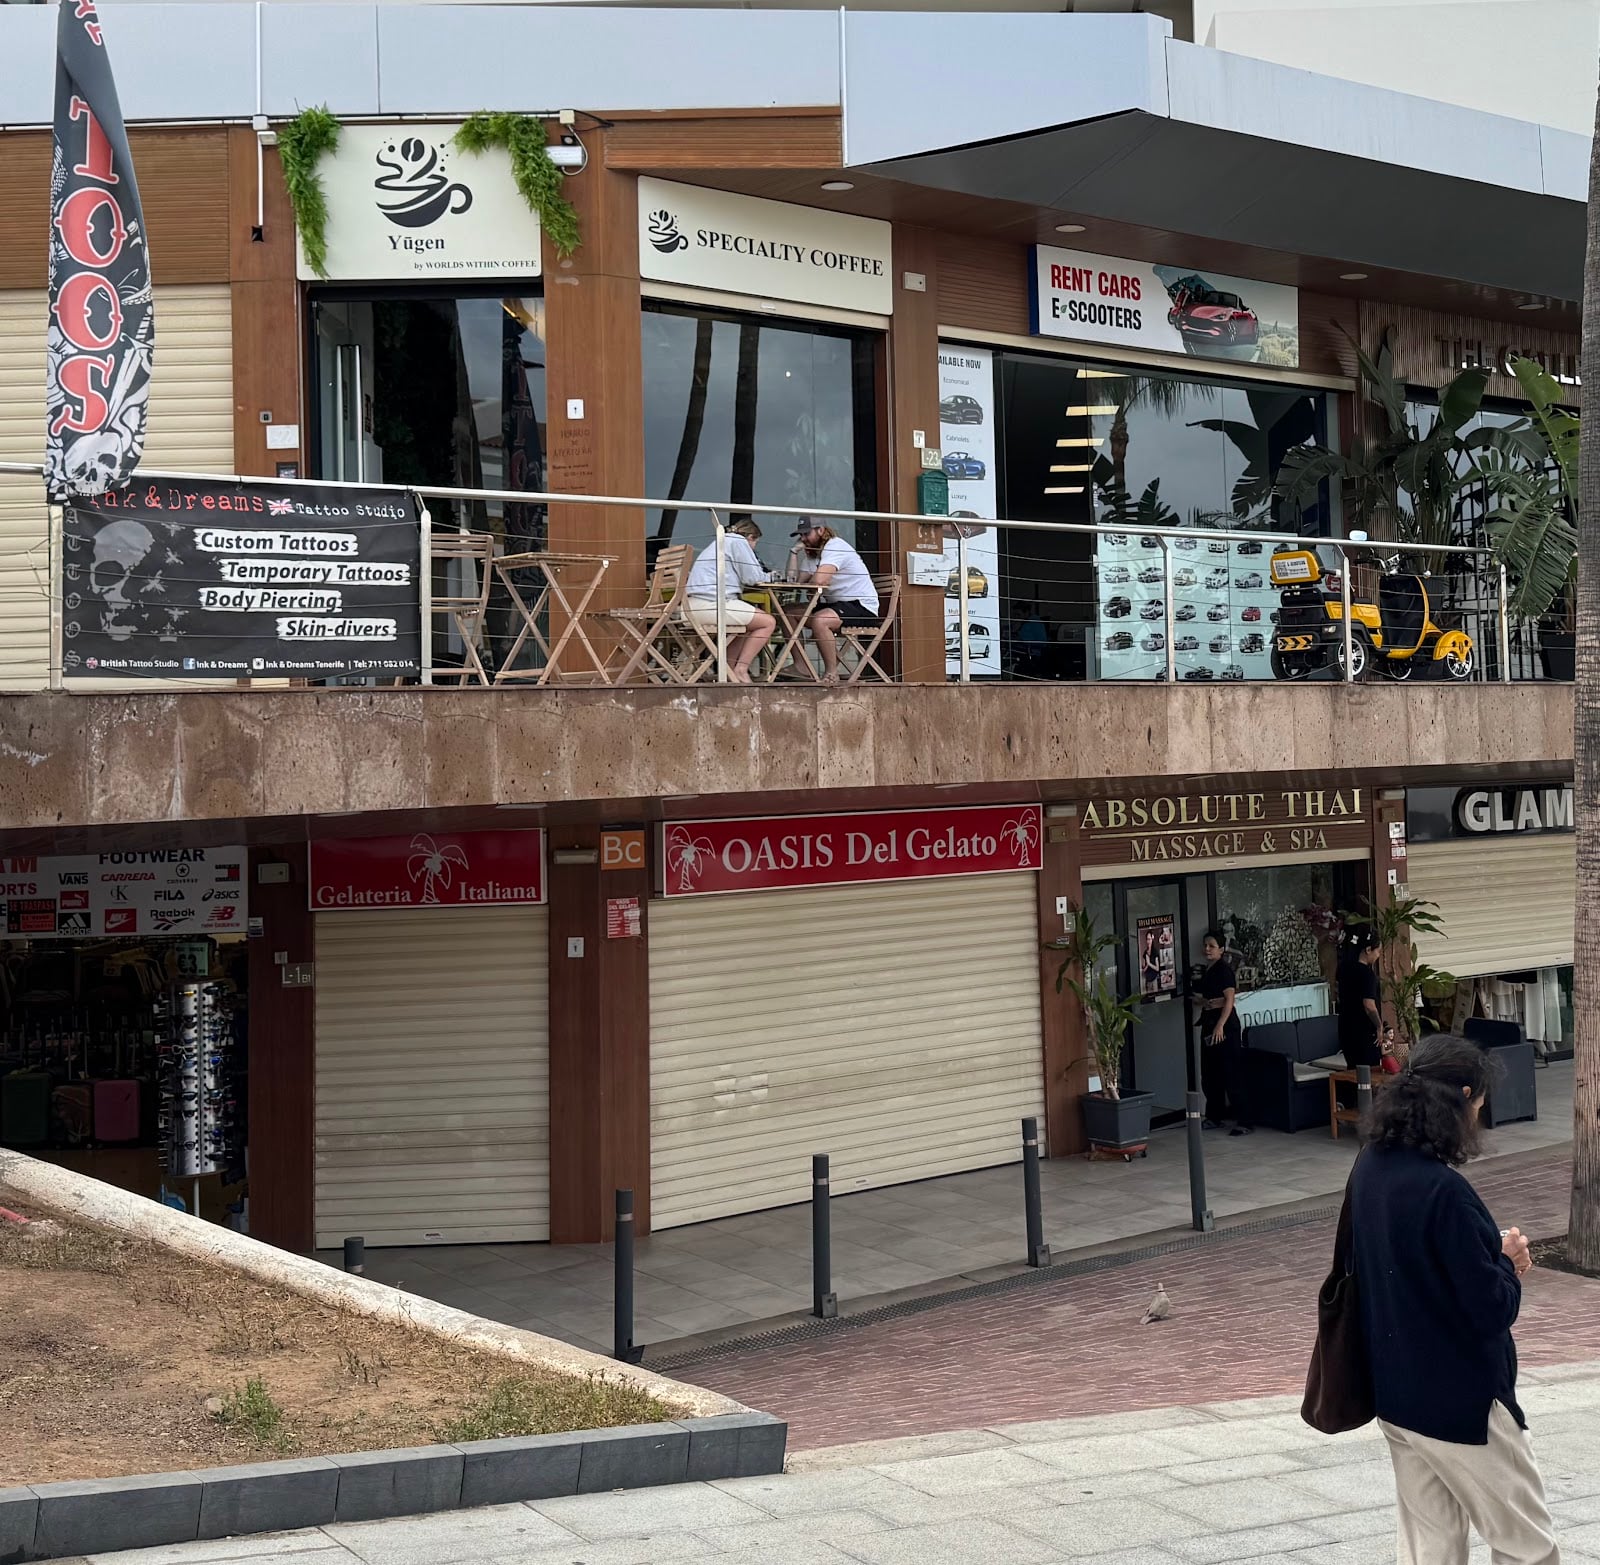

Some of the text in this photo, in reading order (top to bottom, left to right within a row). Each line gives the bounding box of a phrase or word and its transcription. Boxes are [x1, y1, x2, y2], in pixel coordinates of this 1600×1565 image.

[388, 235, 445, 254] Yūgen
[696, 229, 884, 277] SPECIALTY COFFEE
[414, 260, 537, 271] by WORLDS WITHIN COFFEE
[1050, 264, 1141, 301] RENT CARS
[966, 359, 981, 369] NOW
[145, 485, 163, 509] &
[168, 488, 263, 512] Dreams
[295, 502, 349, 517] Tattoo
[356, 504, 405, 519] Studio
[201, 532, 349, 552] Custom Tattoos
[227, 562, 403, 582] Temporary Tattoos
[205, 590, 337, 612] Body Piercing
[286, 620, 389, 636] Skin-divers
[101, 659, 179, 668] British Tattoo Studio
[197, 661, 209, 669] Ink
[219, 661, 247, 669] Dreams
[266, 660, 278, 668] Ink
[279, 660, 285, 668] &
[315, 660, 344, 668] Tenerife
[1080, 787, 1364, 830] ABSOLUTE THAI
[1459, 789, 1574, 832] GLAM
[603, 836, 641, 864] Bc
[722, 825, 998, 873] OASIS Del Gelato
[1130, 828, 1329, 862] MASSAGE & SPA
[98, 850, 205, 864] FOOTWEAR
[58, 872, 89, 885] VANS
[101, 873, 156, 882] CARRERA
[154, 889, 185, 901] FILA
[316, 881, 538, 905] Gelateria Italiana
[150, 908, 196, 920] Reebok
